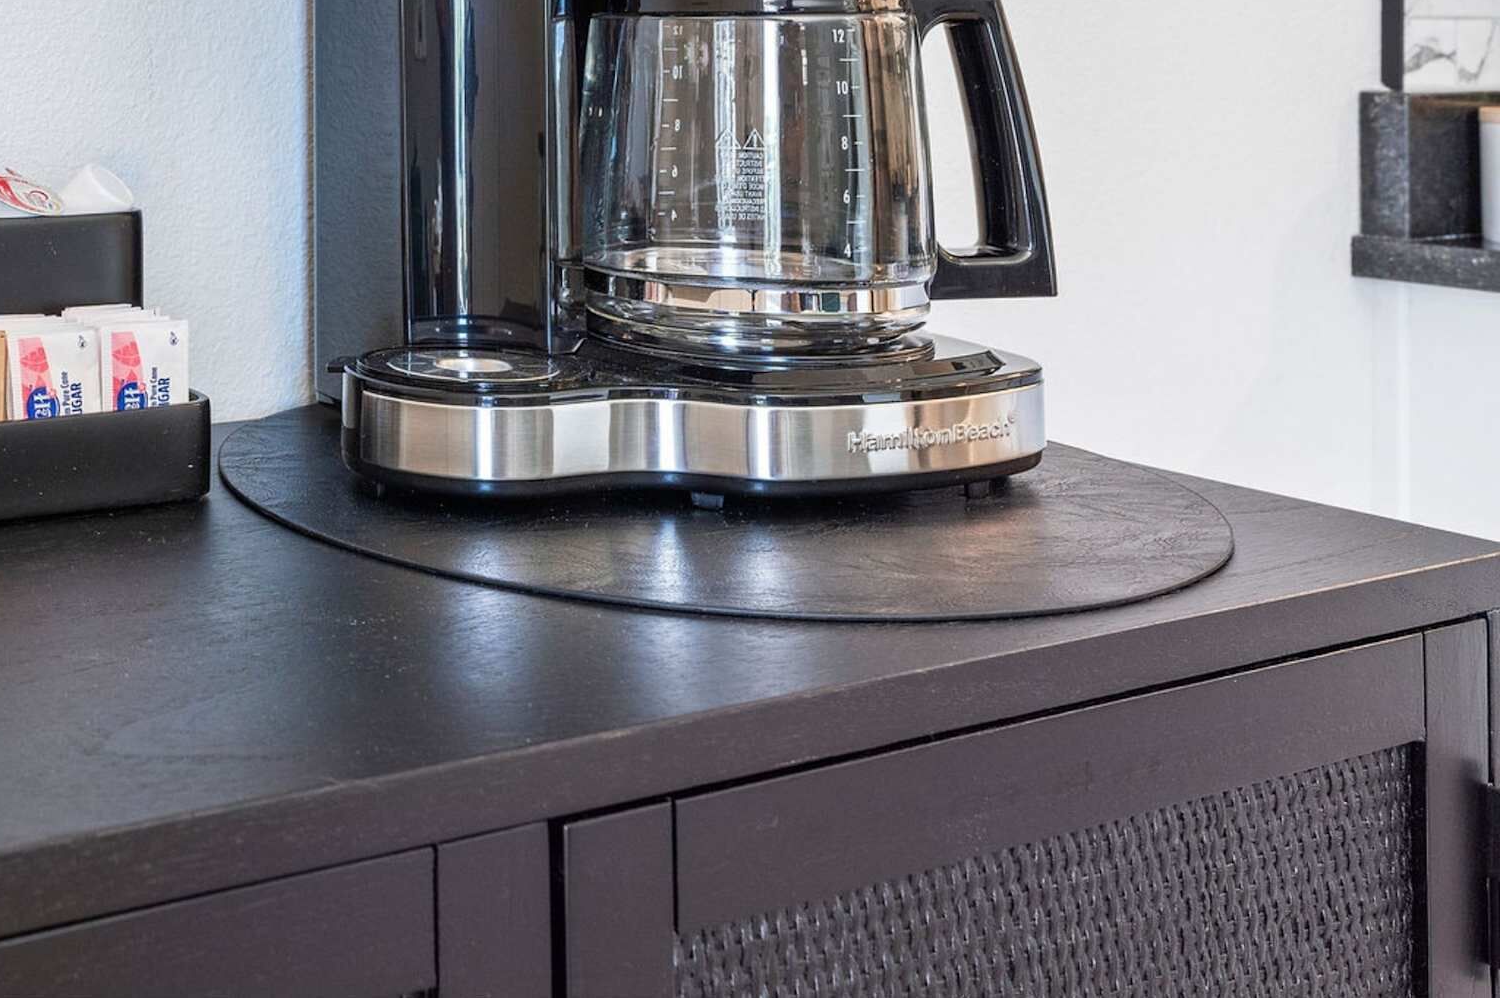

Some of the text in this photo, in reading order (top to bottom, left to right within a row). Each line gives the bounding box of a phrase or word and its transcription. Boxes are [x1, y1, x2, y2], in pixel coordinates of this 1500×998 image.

[832, 29, 845, 43] 12
[835, 81, 849, 95] 10
[841, 136, 848, 151] 8
[843, 190, 851, 204] 6
[843, 243, 851, 259] 4
